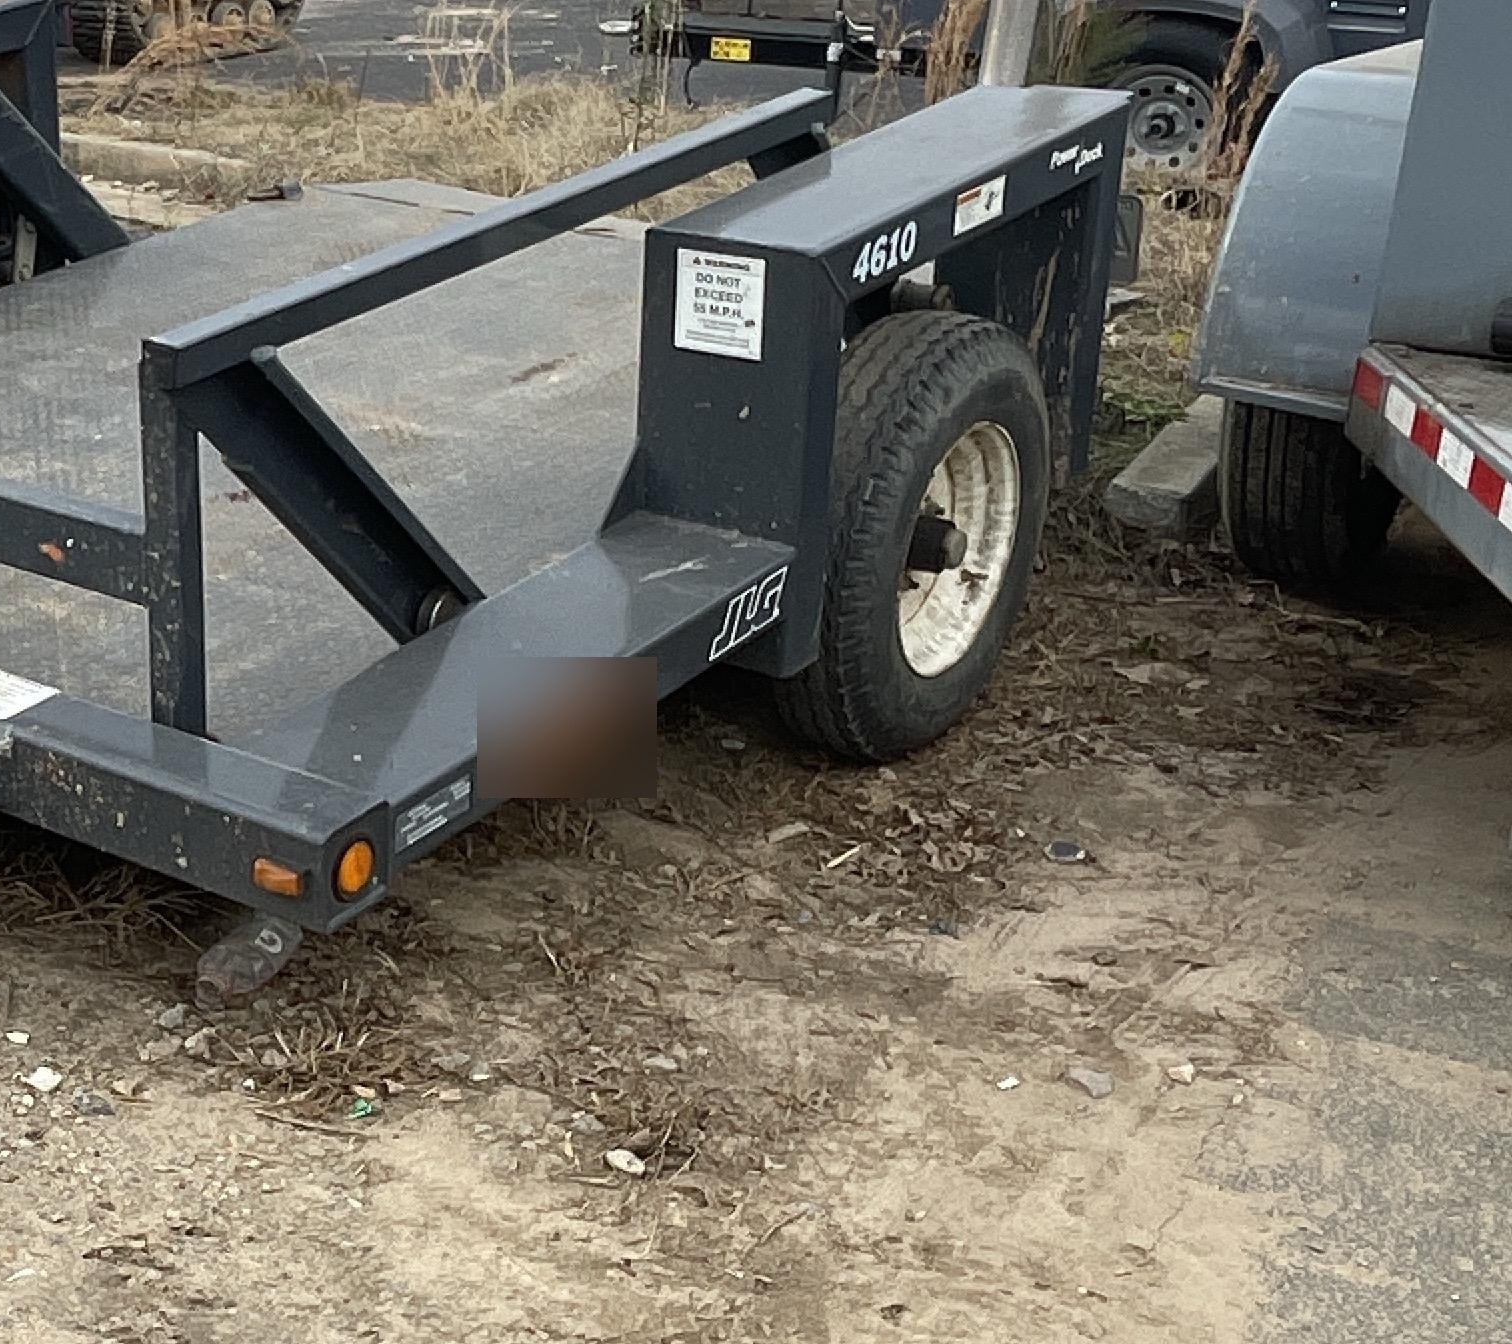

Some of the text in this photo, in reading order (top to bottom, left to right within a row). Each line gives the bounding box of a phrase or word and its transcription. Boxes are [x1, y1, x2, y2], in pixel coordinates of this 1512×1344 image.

[852, 220, 918, 283] 4610
[694, 286, 744, 304] EXCEED
[695, 272, 742, 289] DO NOT
[708, 566, 788, 662] JLG
